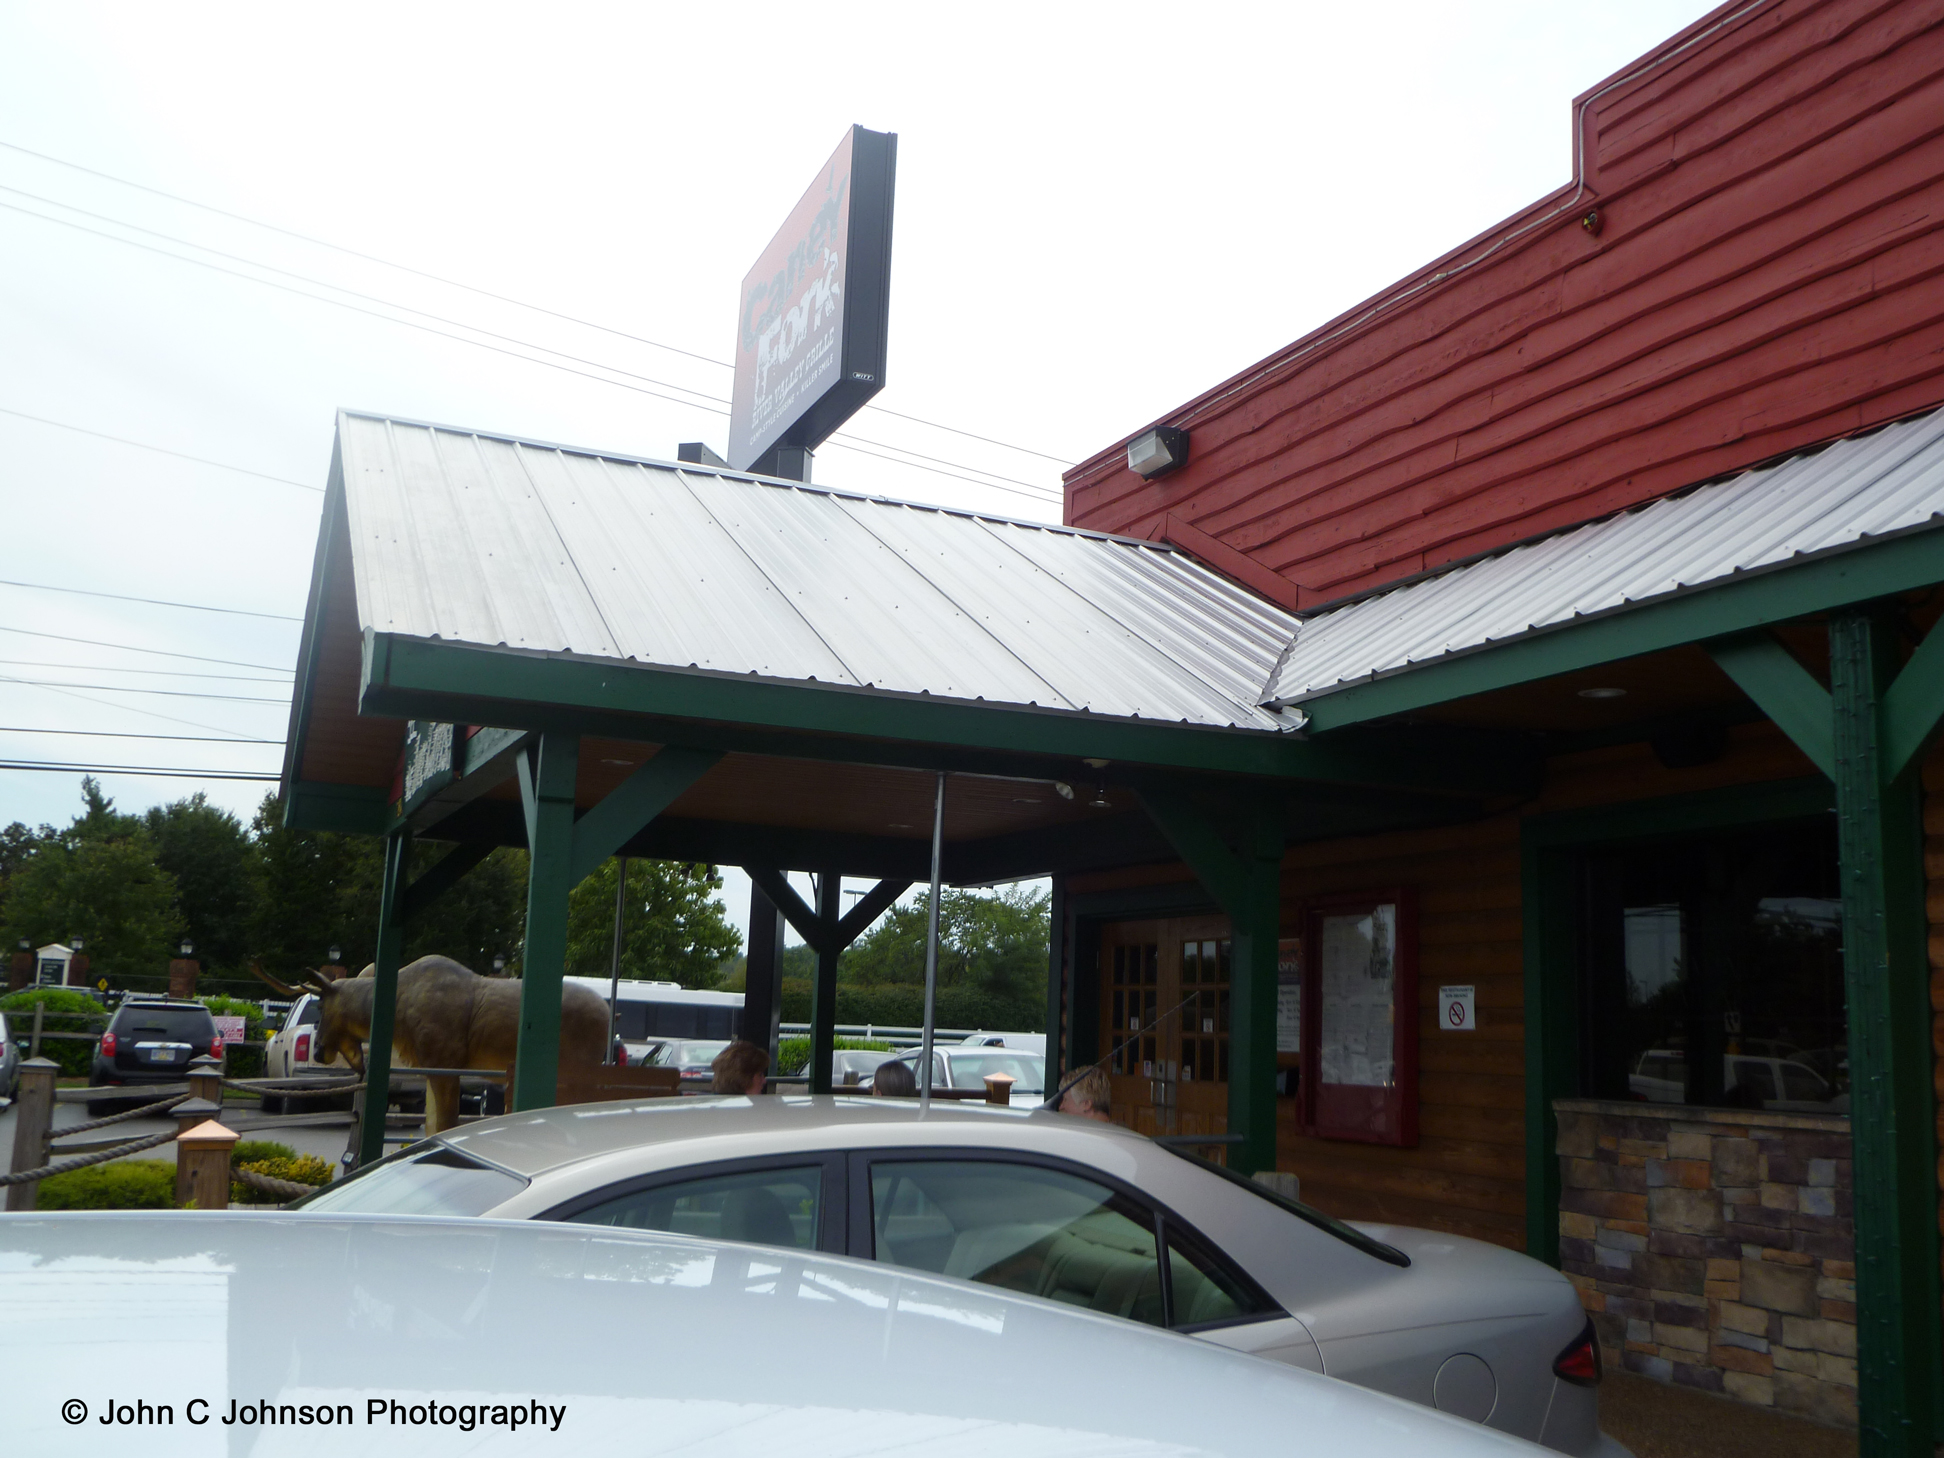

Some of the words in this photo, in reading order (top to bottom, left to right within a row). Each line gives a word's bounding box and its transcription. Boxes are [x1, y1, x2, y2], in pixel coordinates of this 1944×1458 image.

[741, 162, 849, 353] Caney
[750, 413, 776, 445] CAMP-STYLE
[776, 395, 795, 418] CUISINE
[801, 373, 818, 393] KILLER
[818, 353, 834, 376] SMILE
[751, 395, 773, 428] RIVER
[775, 358, 804, 406] VALLEY
[804, 327, 835, 374] GRILLE
